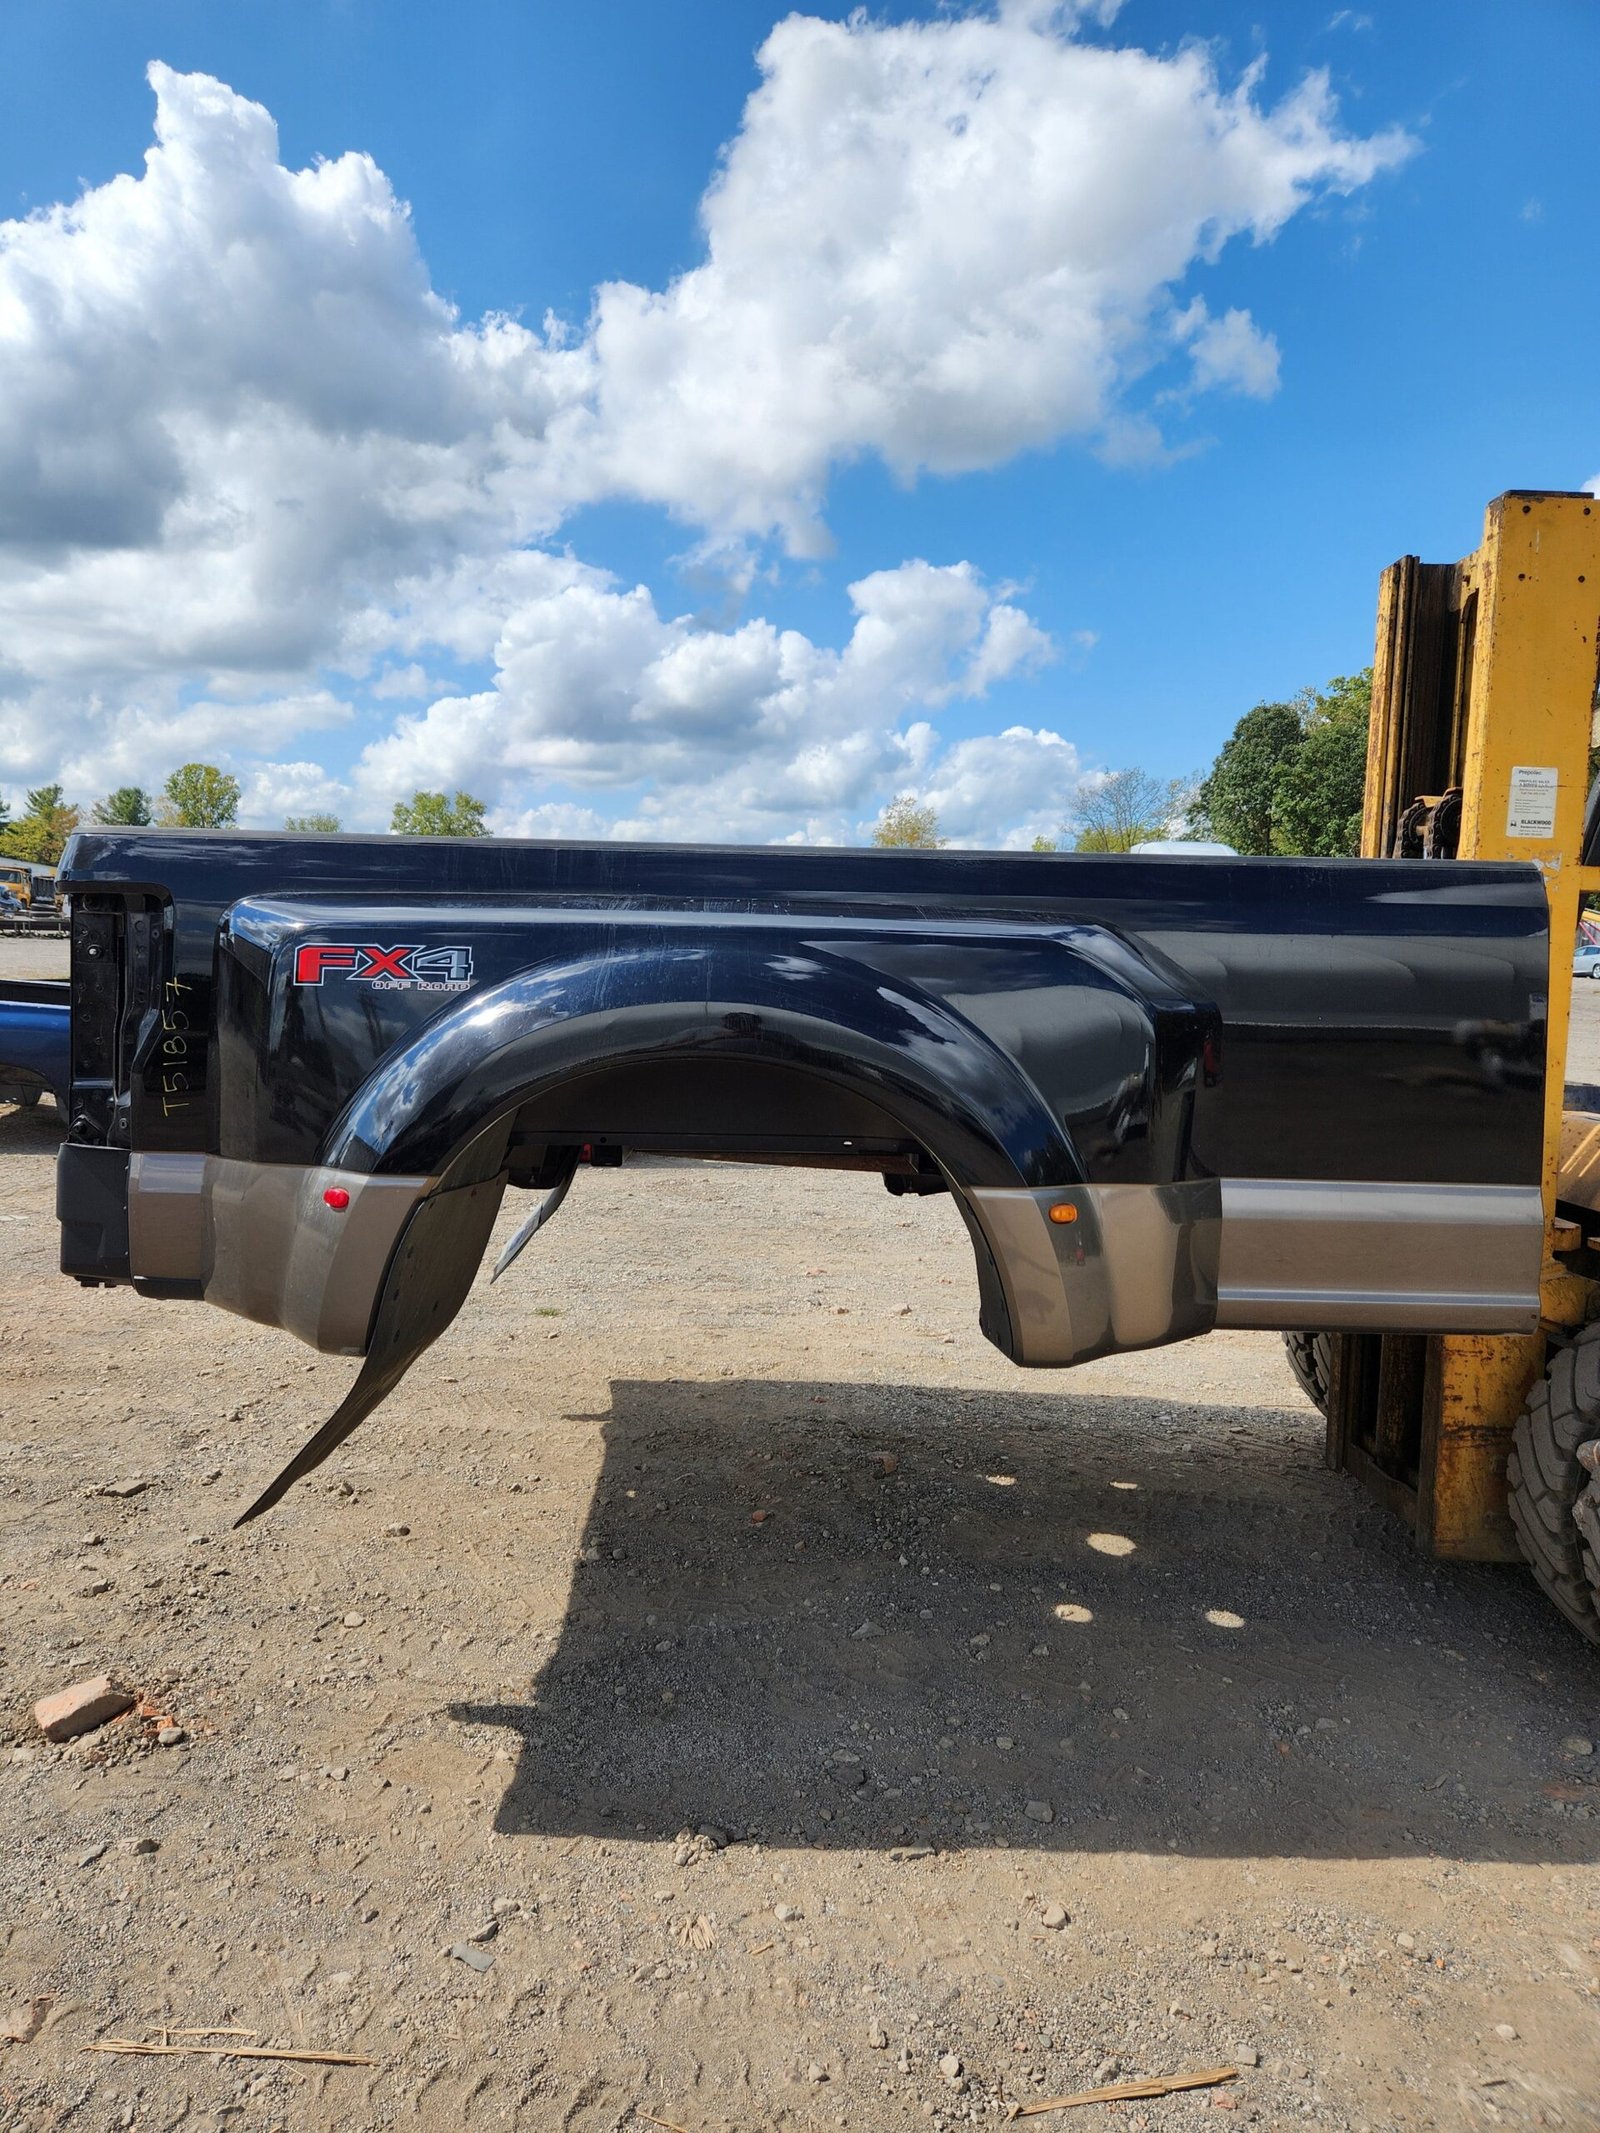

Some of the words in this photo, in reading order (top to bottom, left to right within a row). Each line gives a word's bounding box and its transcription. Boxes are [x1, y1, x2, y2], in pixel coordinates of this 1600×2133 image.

[294, 943, 473, 986] FX4
[372, 981, 411, 990] OFF
[417, 981, 471, 992] ROAD
[162, 976, 193, 1117] T51857
